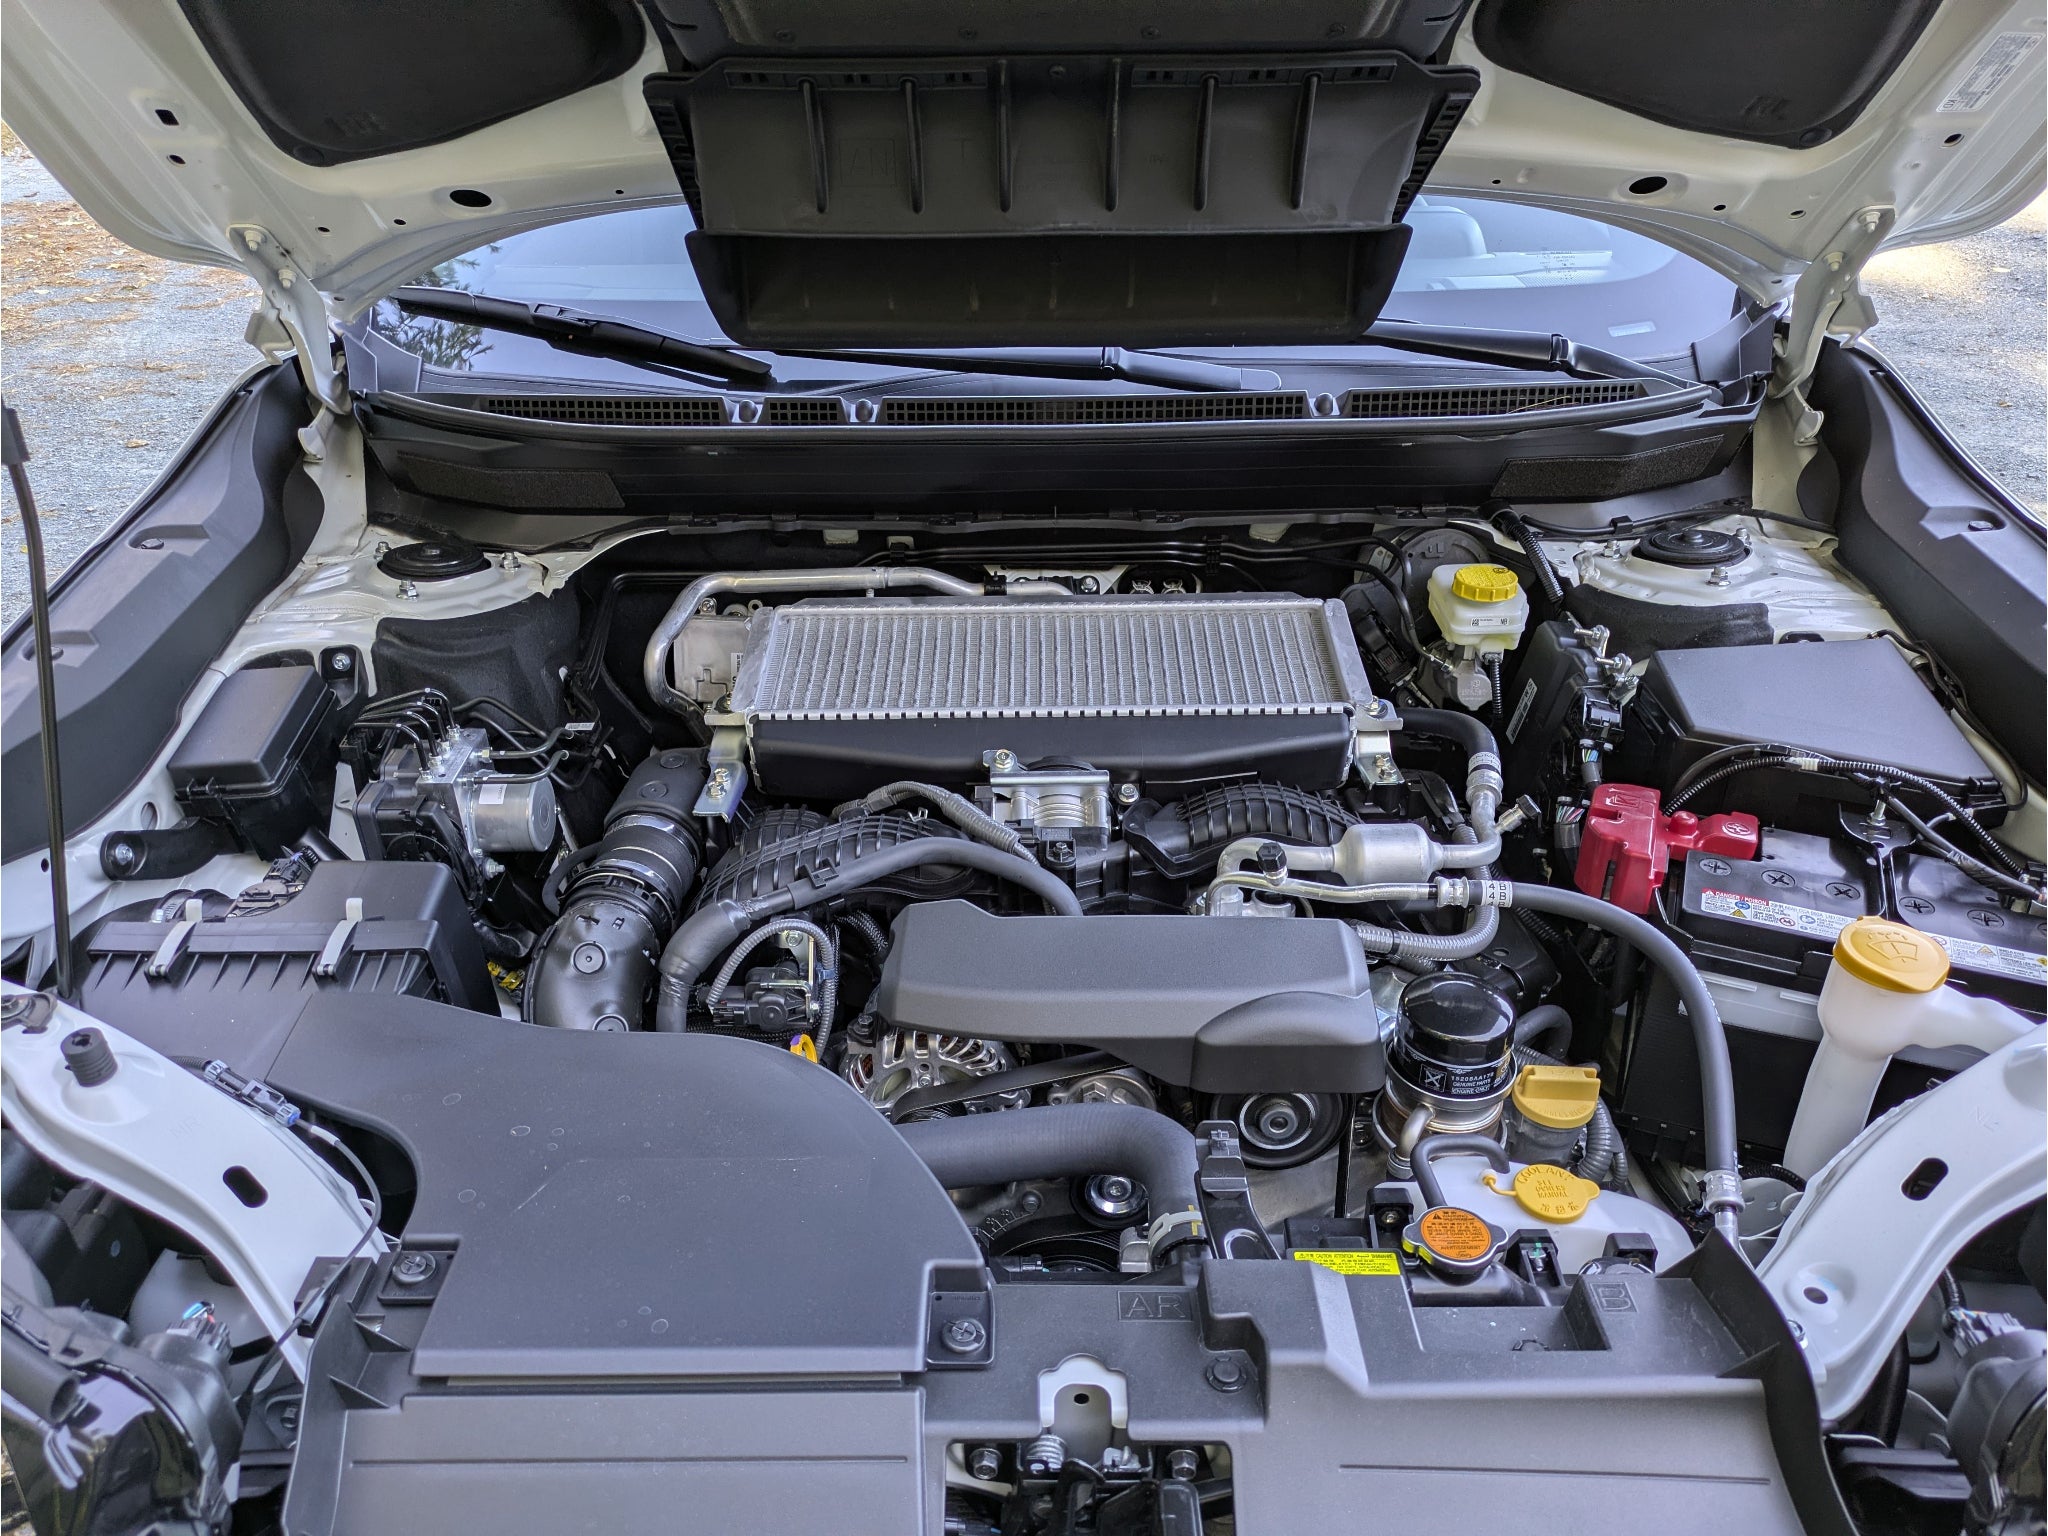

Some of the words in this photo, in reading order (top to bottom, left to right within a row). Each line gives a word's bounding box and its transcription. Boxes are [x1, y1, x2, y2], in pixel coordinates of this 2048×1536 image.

[1715, 891, 1741, 901] DANGER
[1744, 896, 1768, 905] POISON
[1516, 1166, 1575, 1184] COOLANT
[1537, 1190, 1568, 1198] MANUAL
[1125, 1293, 1186, 1318] AR
[1599, 1287, 1631, 1310] B
